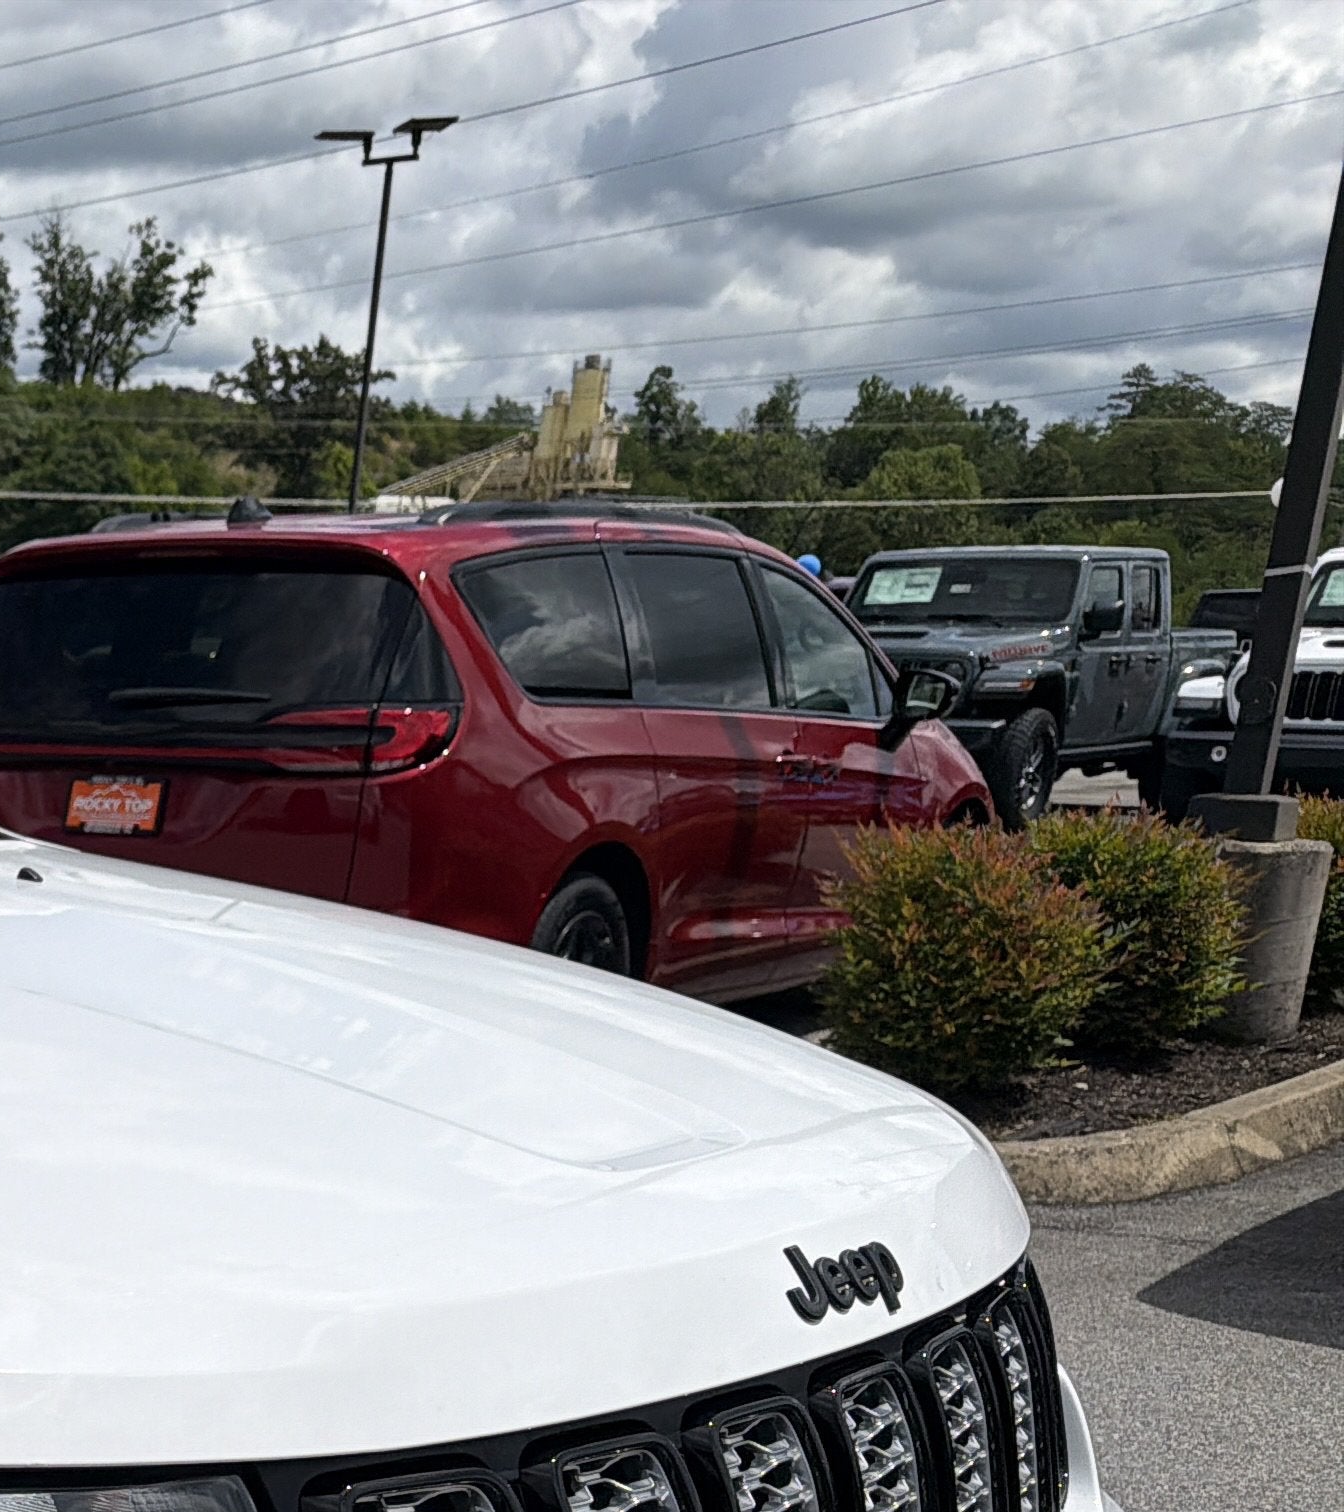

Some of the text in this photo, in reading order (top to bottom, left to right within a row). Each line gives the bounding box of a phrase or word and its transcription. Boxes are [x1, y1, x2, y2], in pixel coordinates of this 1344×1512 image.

[73, 796, 154, 813] ROCKY TOP
[783, 1240, 905, 1326] Jeep
